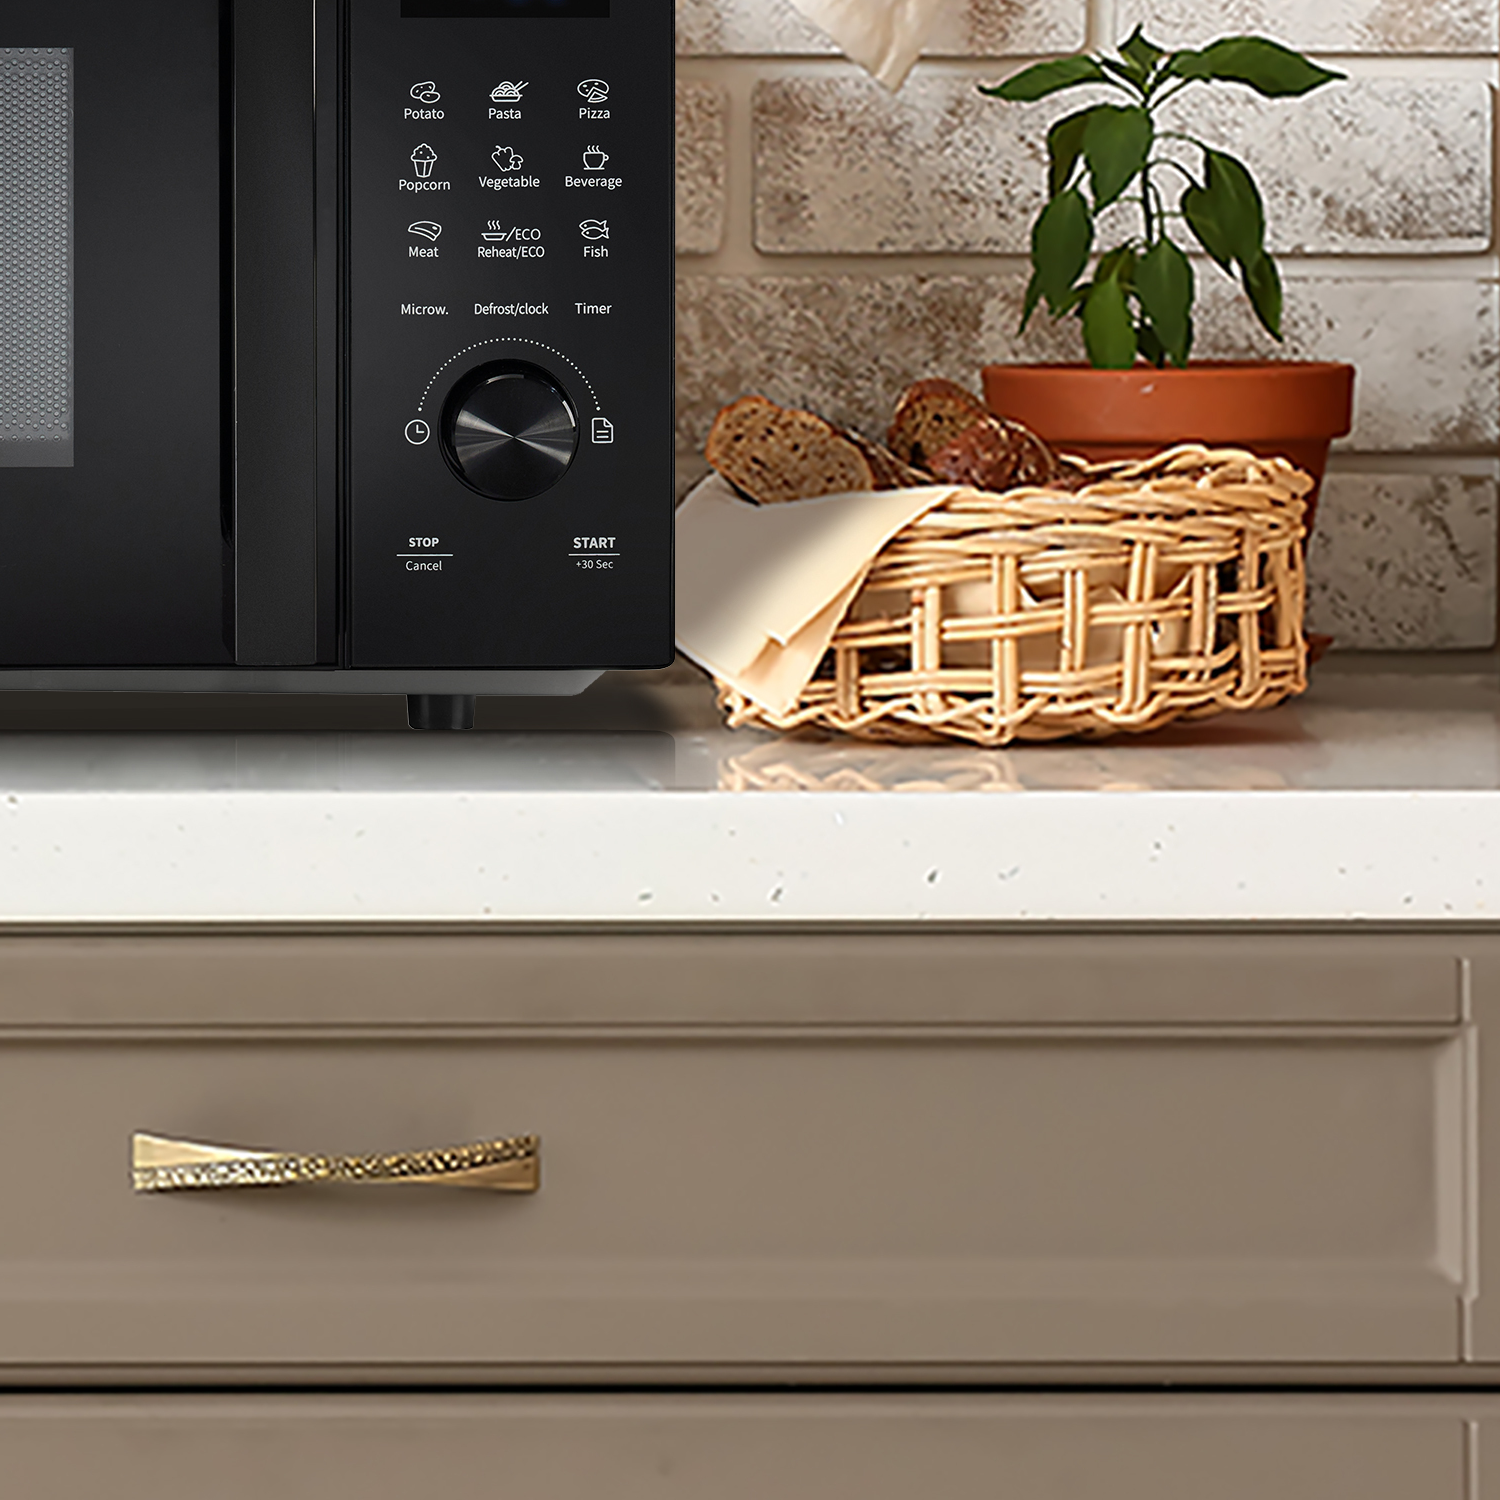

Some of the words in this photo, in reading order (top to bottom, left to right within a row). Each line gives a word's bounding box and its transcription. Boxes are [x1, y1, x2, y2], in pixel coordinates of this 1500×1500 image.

[404, 107, 445, 120] Potato
[488, 107, 522, 120] Pasta
[579, 107, 611, 119] Pizza
[398, 179, 451, 194] Popcorn
[478, 175, 541, 191] Vegetable
[565, 175, 623, 191] Beverage
[408, 245, 439, 258] Meat
[477, 245, 545, 260] Reheat/ECO
[583, 245, 609, 258] Fish
[401, 303, 449, 316] Microw.
[474, 302, 549, 317] Defrost/clock
[574, 302, 613, 315] Timer
[408, 537, 440, 548] STOP
[573, 536, 617, 549] START
[405, 560, 443, 571] Cancel
[575, 559, 594, 570] +30
[595, 559, 614, 570] Sec
